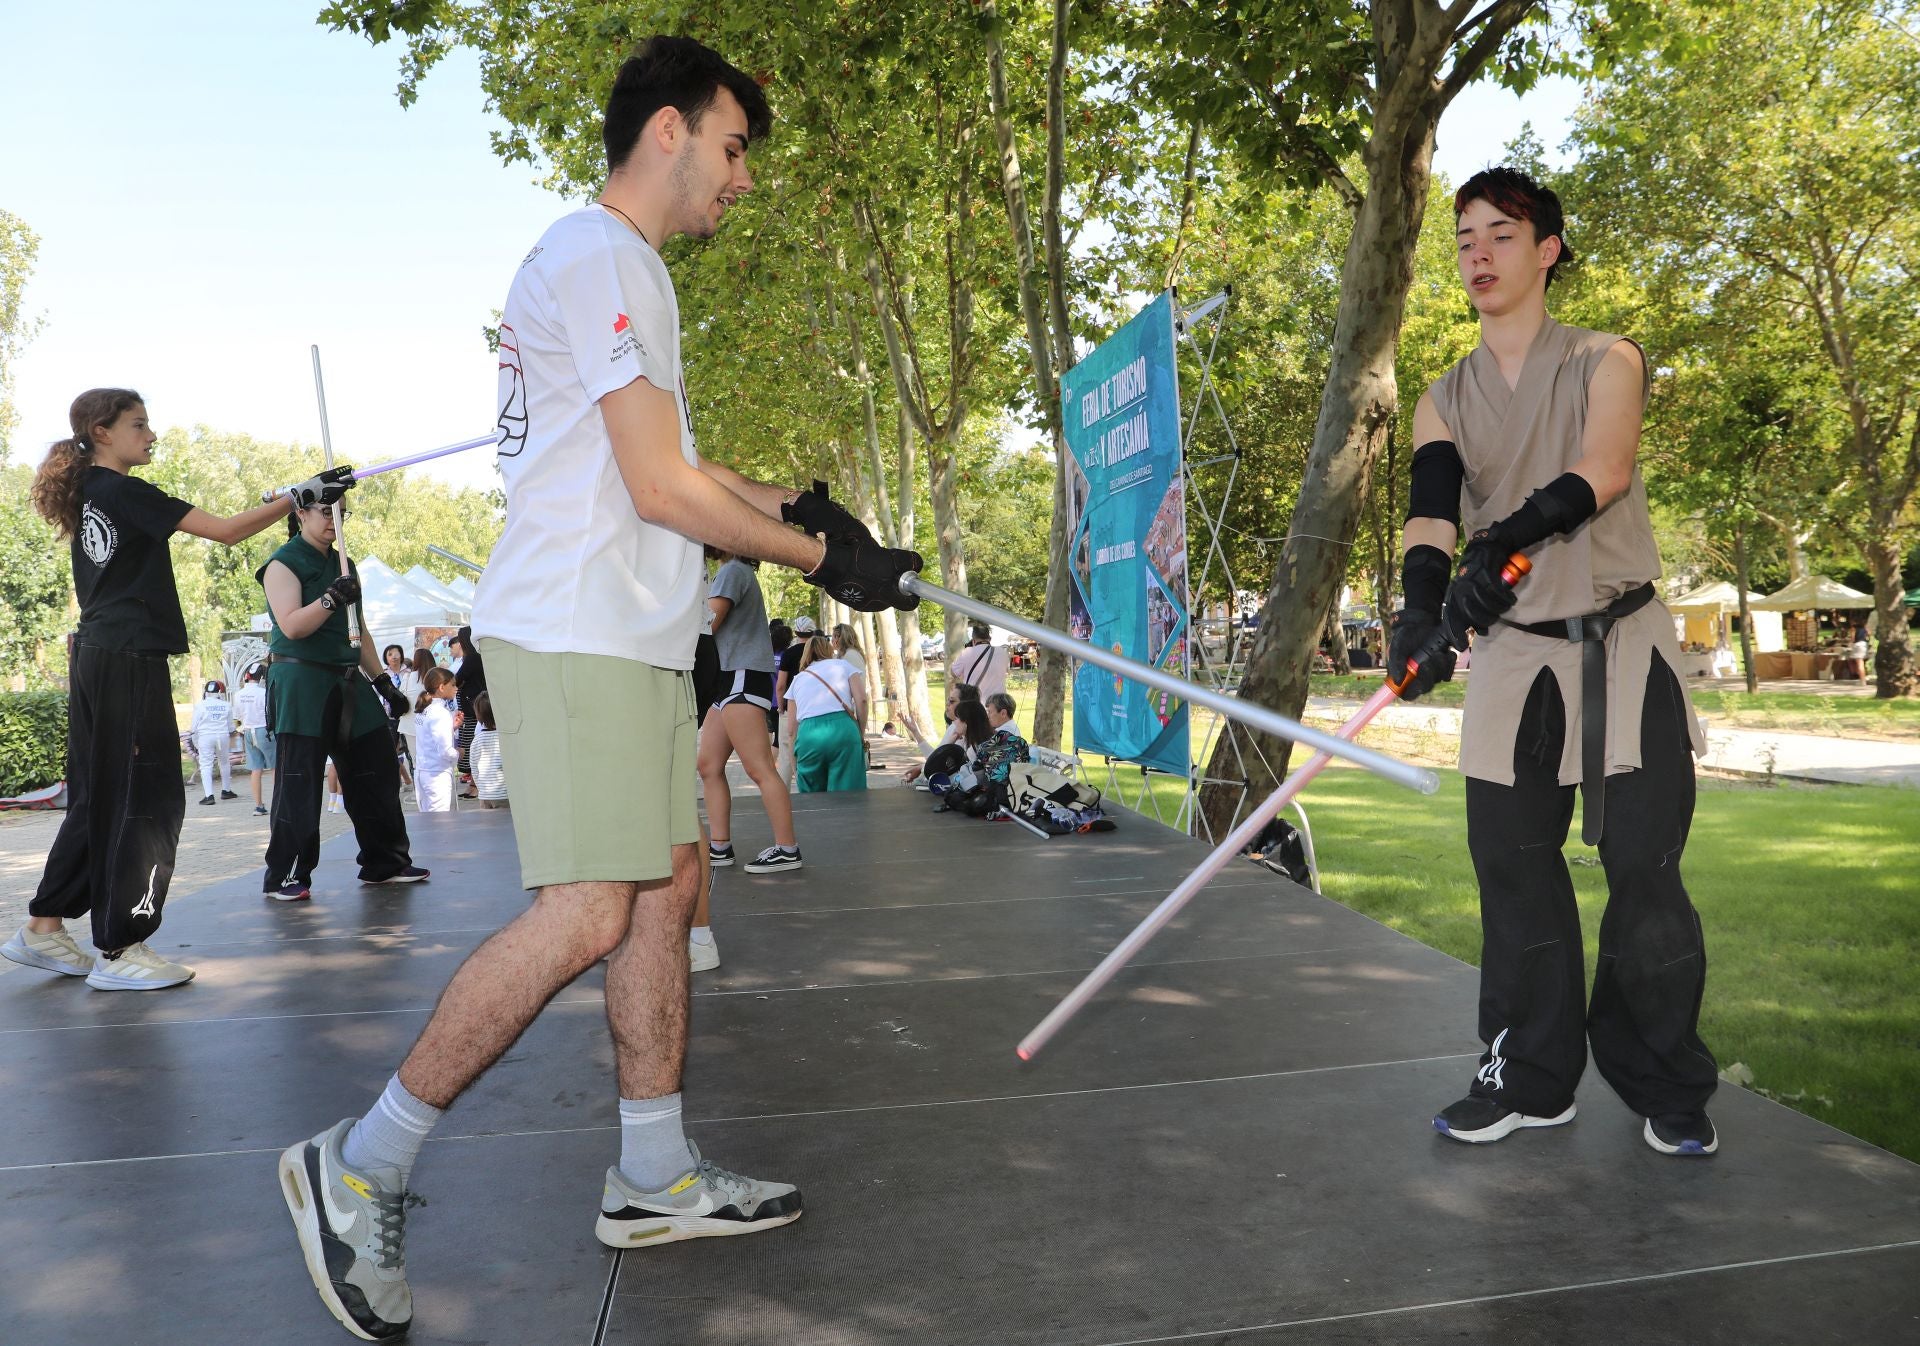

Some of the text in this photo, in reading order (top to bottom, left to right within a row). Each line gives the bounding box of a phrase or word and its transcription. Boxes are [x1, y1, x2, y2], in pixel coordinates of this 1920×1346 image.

[1082, 387, 1100, 430] FERIA
[1101, 379, 1111, 418] DE
[1112, 355, 1147, 411] TURISMO
[1100, 434, 1105, 468] Y
[1107, 404, 1150, 467] ARTESANÍA
[109, 525, 118, 548] COMBAT
